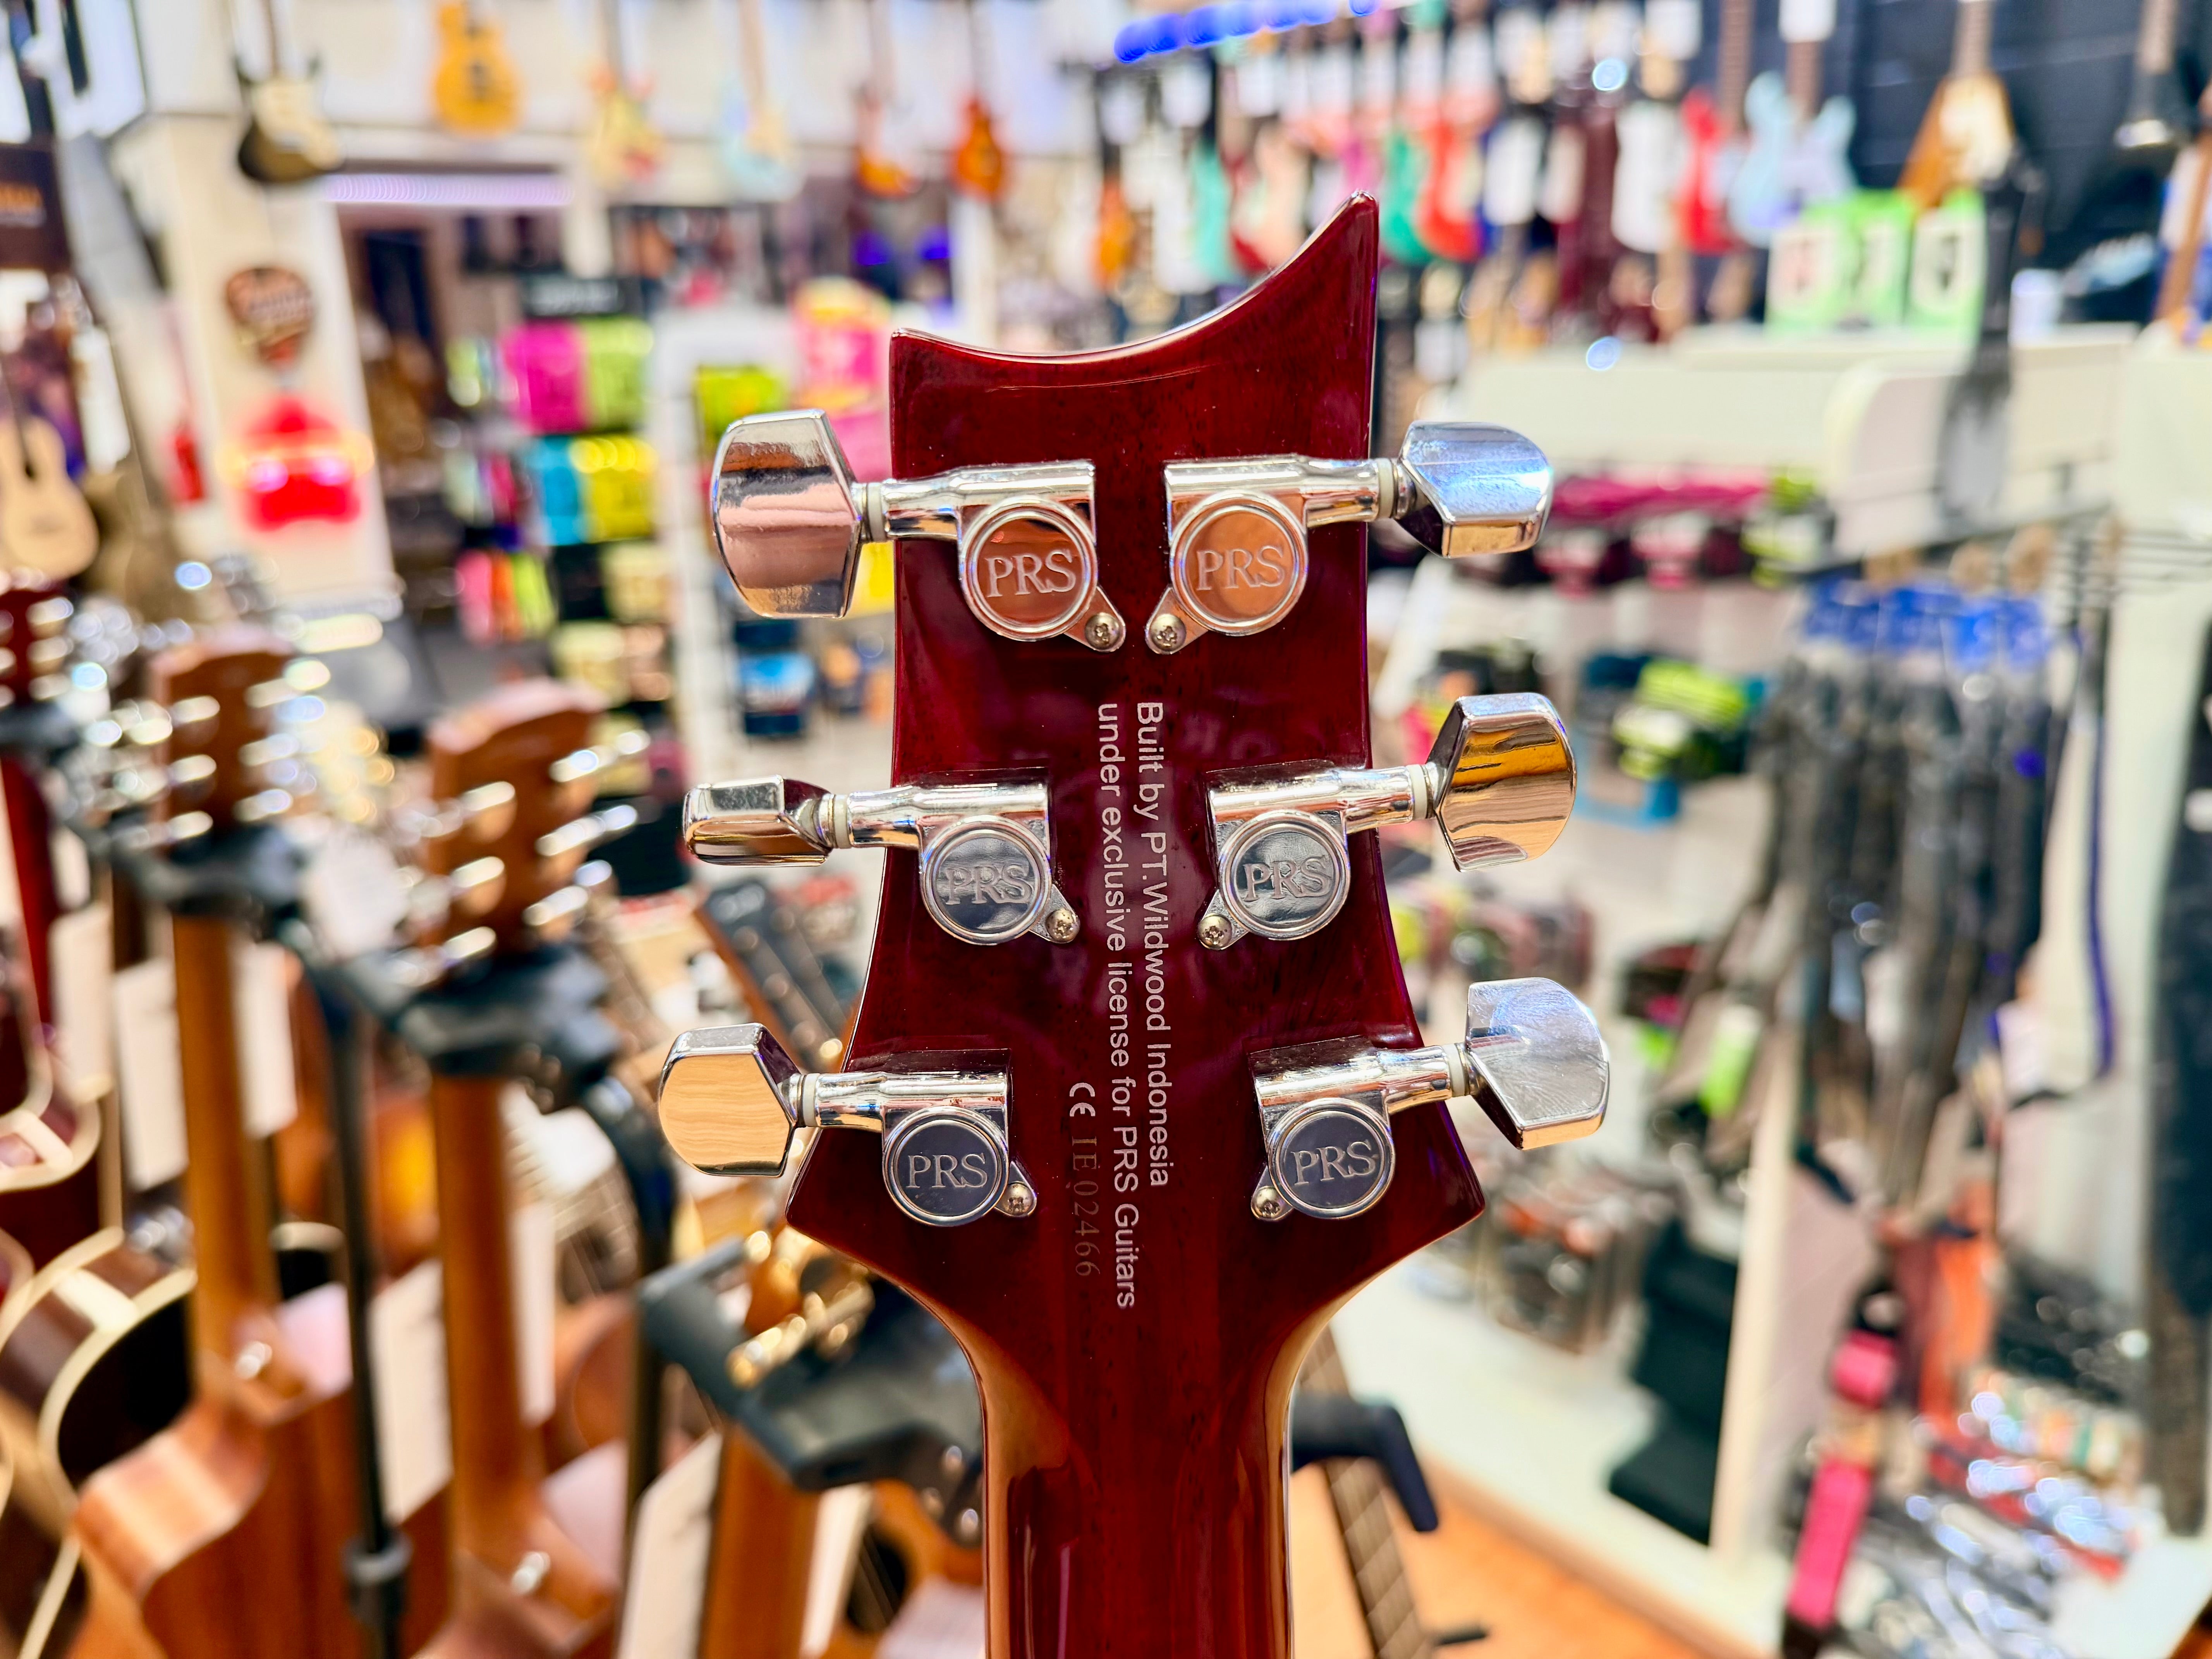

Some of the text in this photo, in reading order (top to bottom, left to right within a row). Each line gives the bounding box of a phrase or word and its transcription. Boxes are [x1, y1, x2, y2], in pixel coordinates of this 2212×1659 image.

[986, 549, 1077, 598] PRS
[1197, 545, 1286, 591] PRS
[1137, 702, 1164, 773] Built
[1133, 783, 1165, 821] by
[946, 860, 1032, 905] PRS
[1242, 855, 1332, 902] PRS
[1098, 704, 1139, 1308] under exclusive license for PRS Guitars
[1147, 1044, 1174, 1186] Indonesia
[906, 1153, 988, 1189] PRS
[1293, 1141, 1376, 1186] PRS
